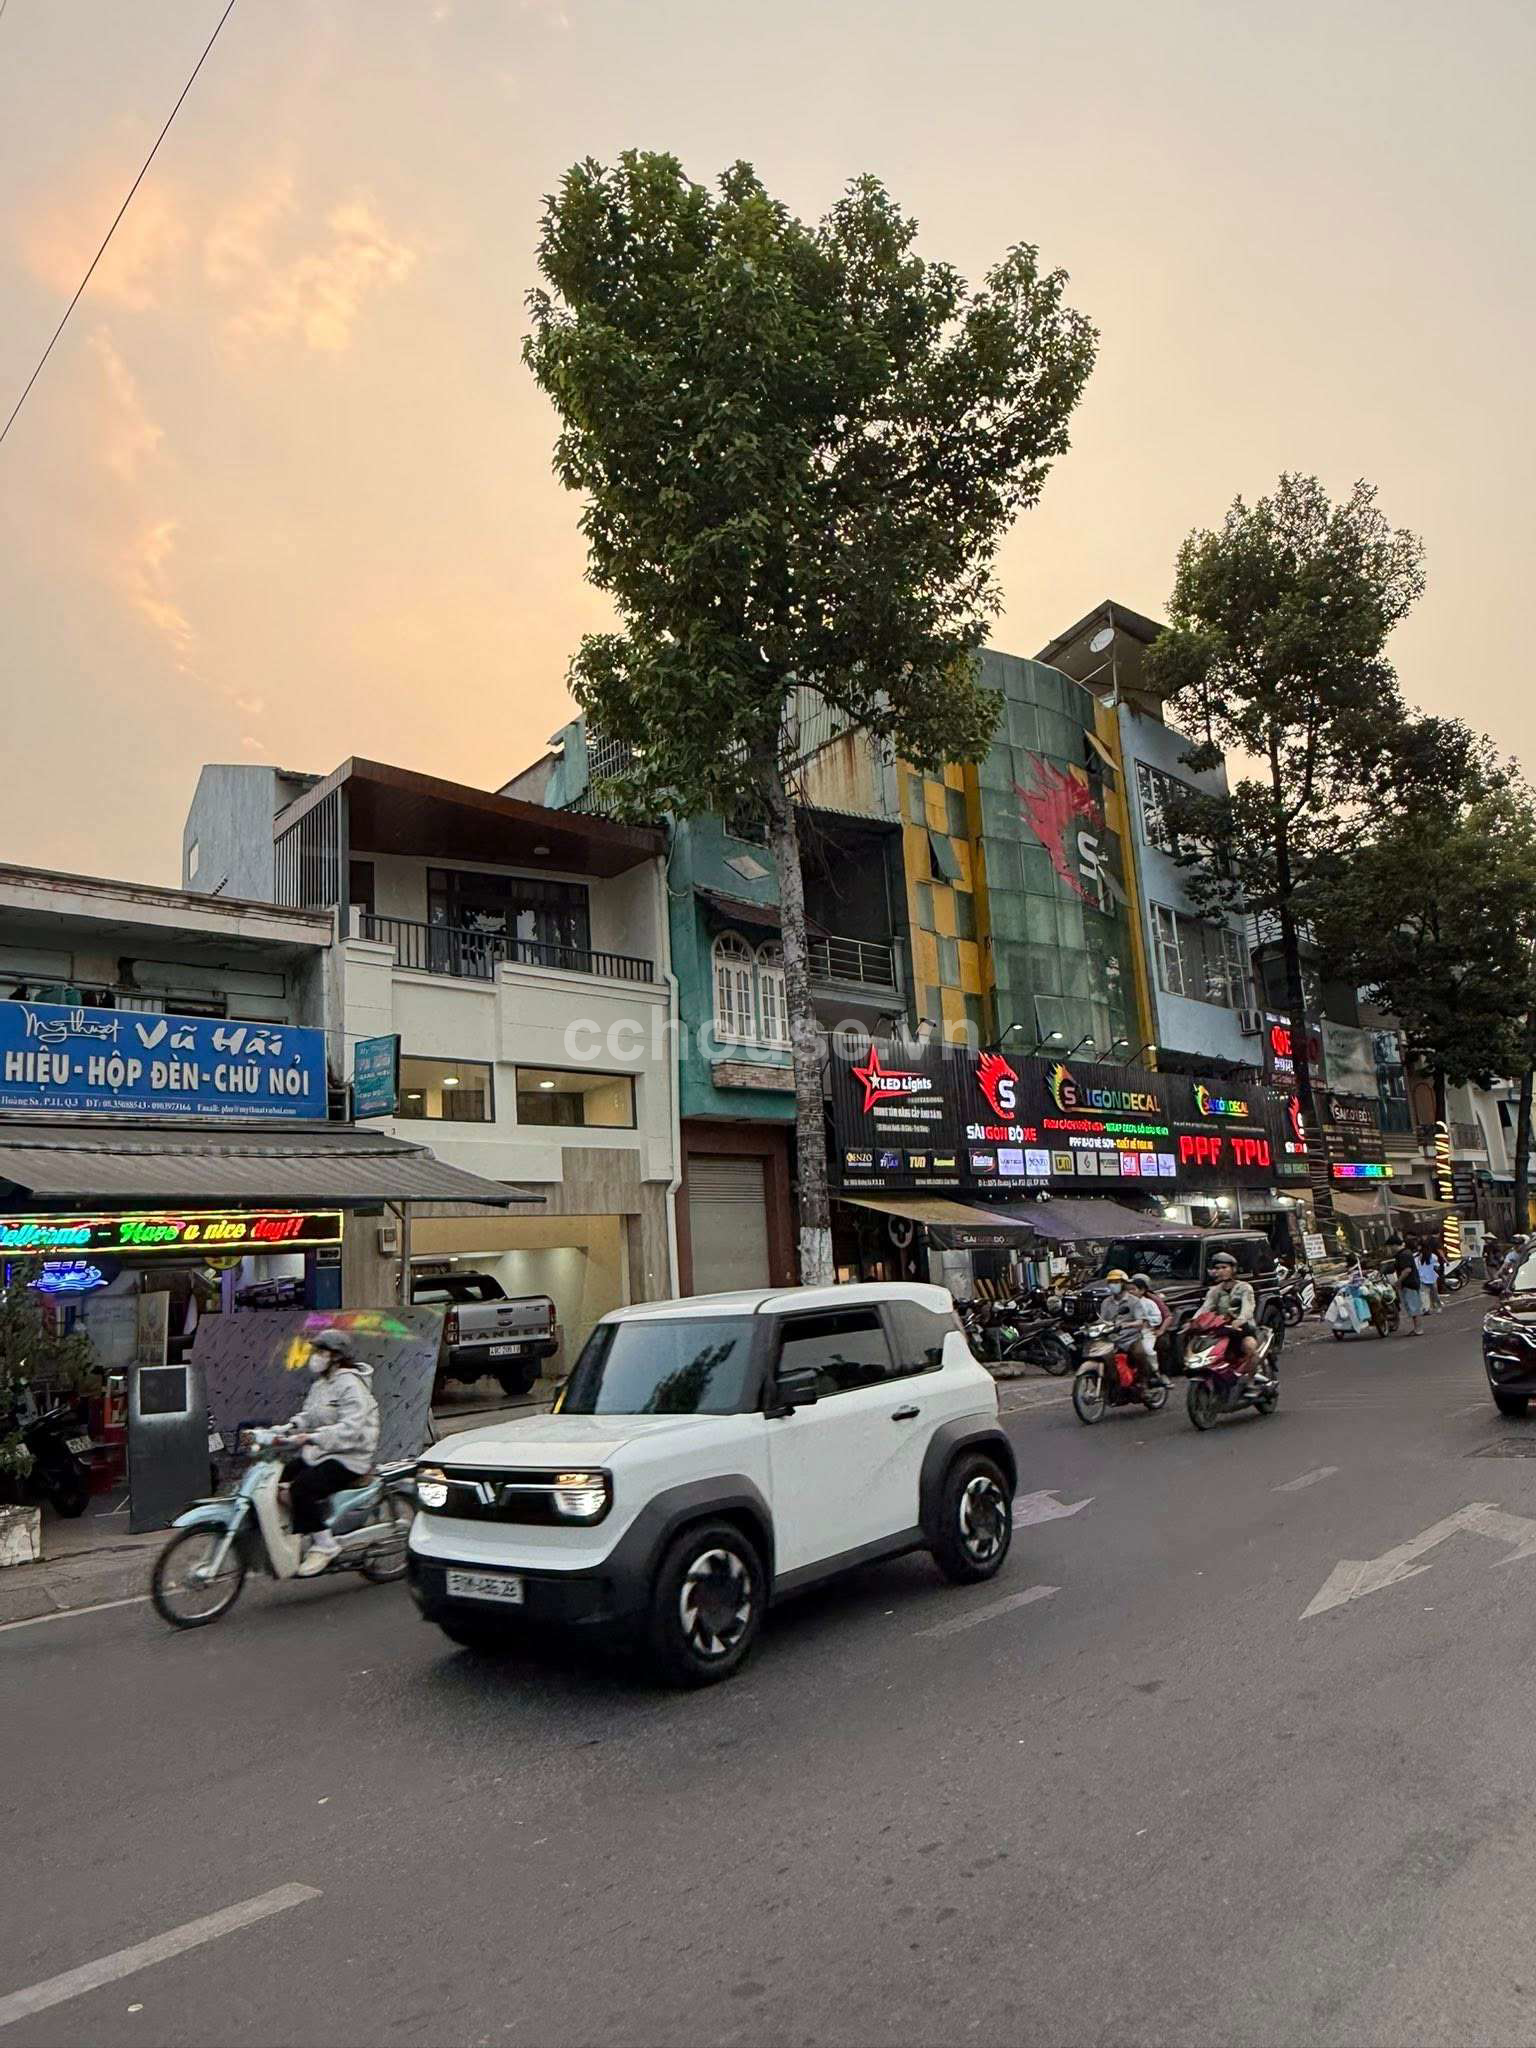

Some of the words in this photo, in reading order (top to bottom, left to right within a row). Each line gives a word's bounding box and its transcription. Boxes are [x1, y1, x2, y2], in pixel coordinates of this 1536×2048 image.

[880, 1077, 901, 1090] LED
[902, 1076, 932, 1093] Lights
[998, 1079, 1016, 1109] S
[1179, 1135, 1222, 1166] PPF
[1231, 1138, 1271, 1167] TPU
[183, 1224, 201, 1241] a
[203, 1219, 247, 1241] nice
[250, 1217, 305, 1241] day!!
